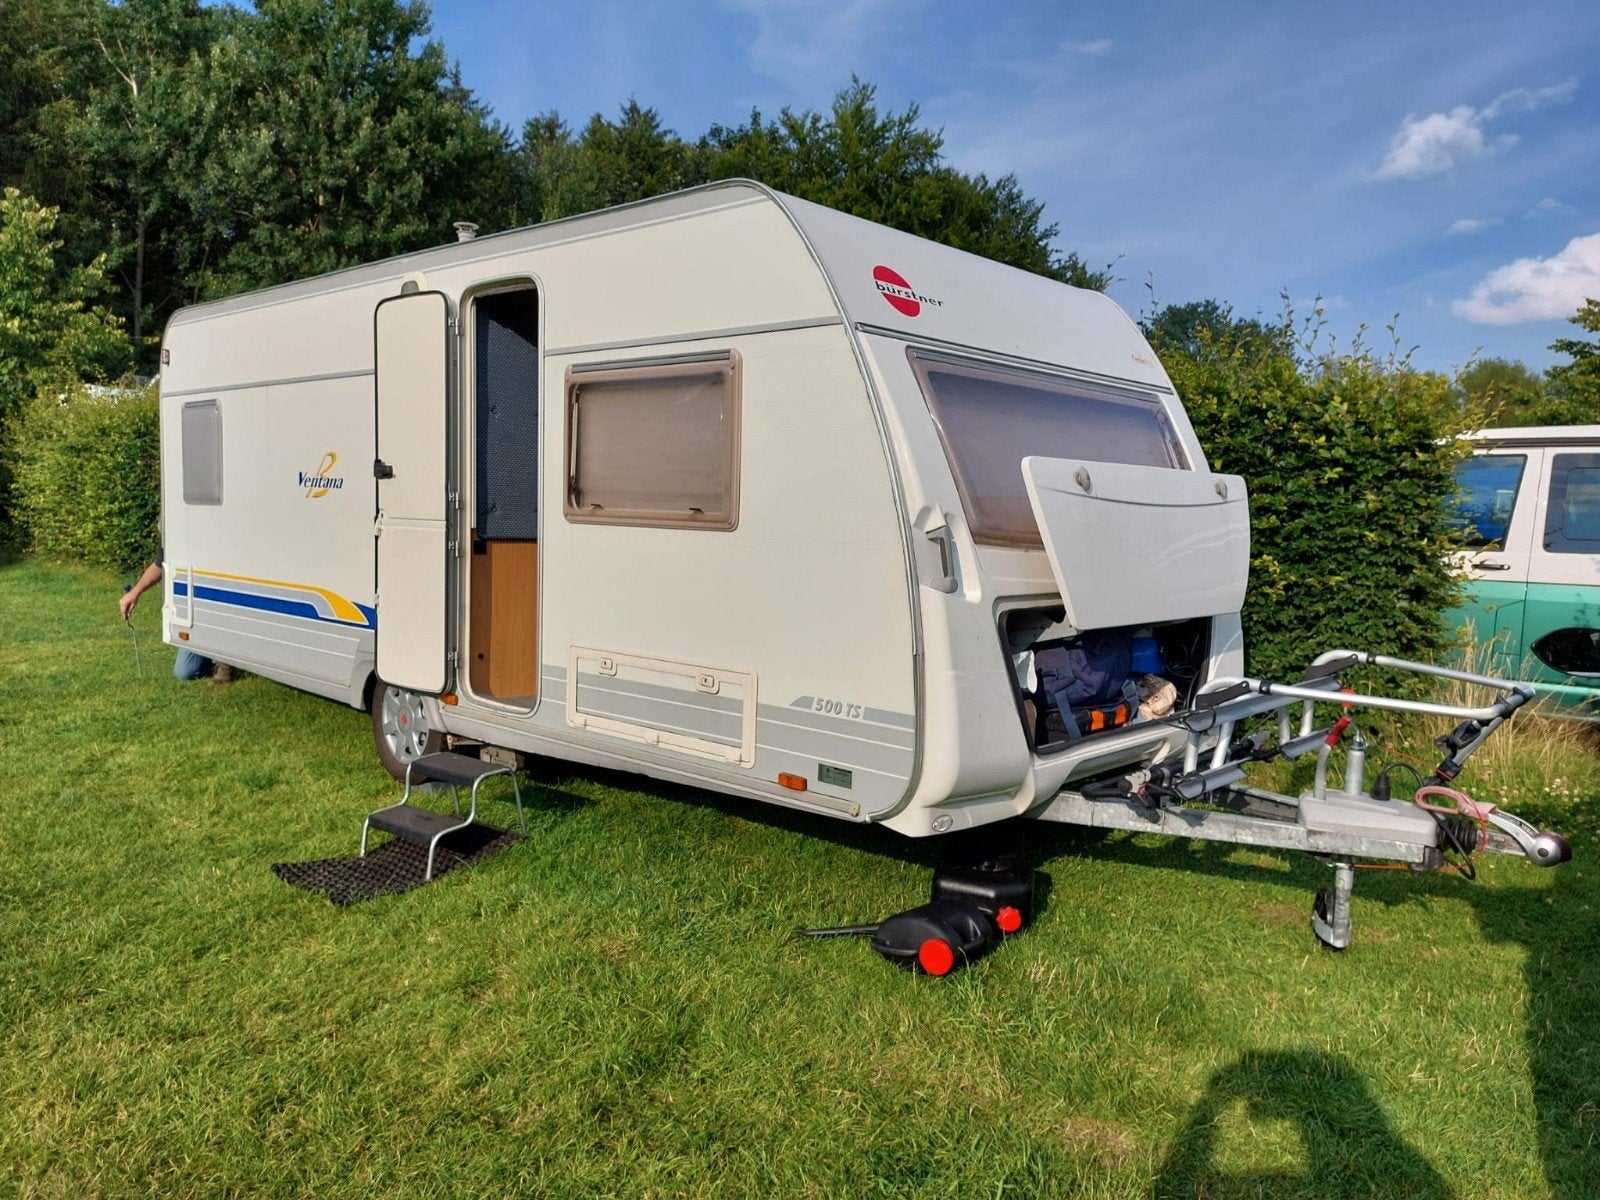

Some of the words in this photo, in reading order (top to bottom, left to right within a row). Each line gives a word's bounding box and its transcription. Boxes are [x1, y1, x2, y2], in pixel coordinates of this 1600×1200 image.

[875, 280, 944, 307] bürstner
[298, 471, 344, 489] Ventana
[814, 697, 843, 715] 500
[845, 702, 862, 719] TS
